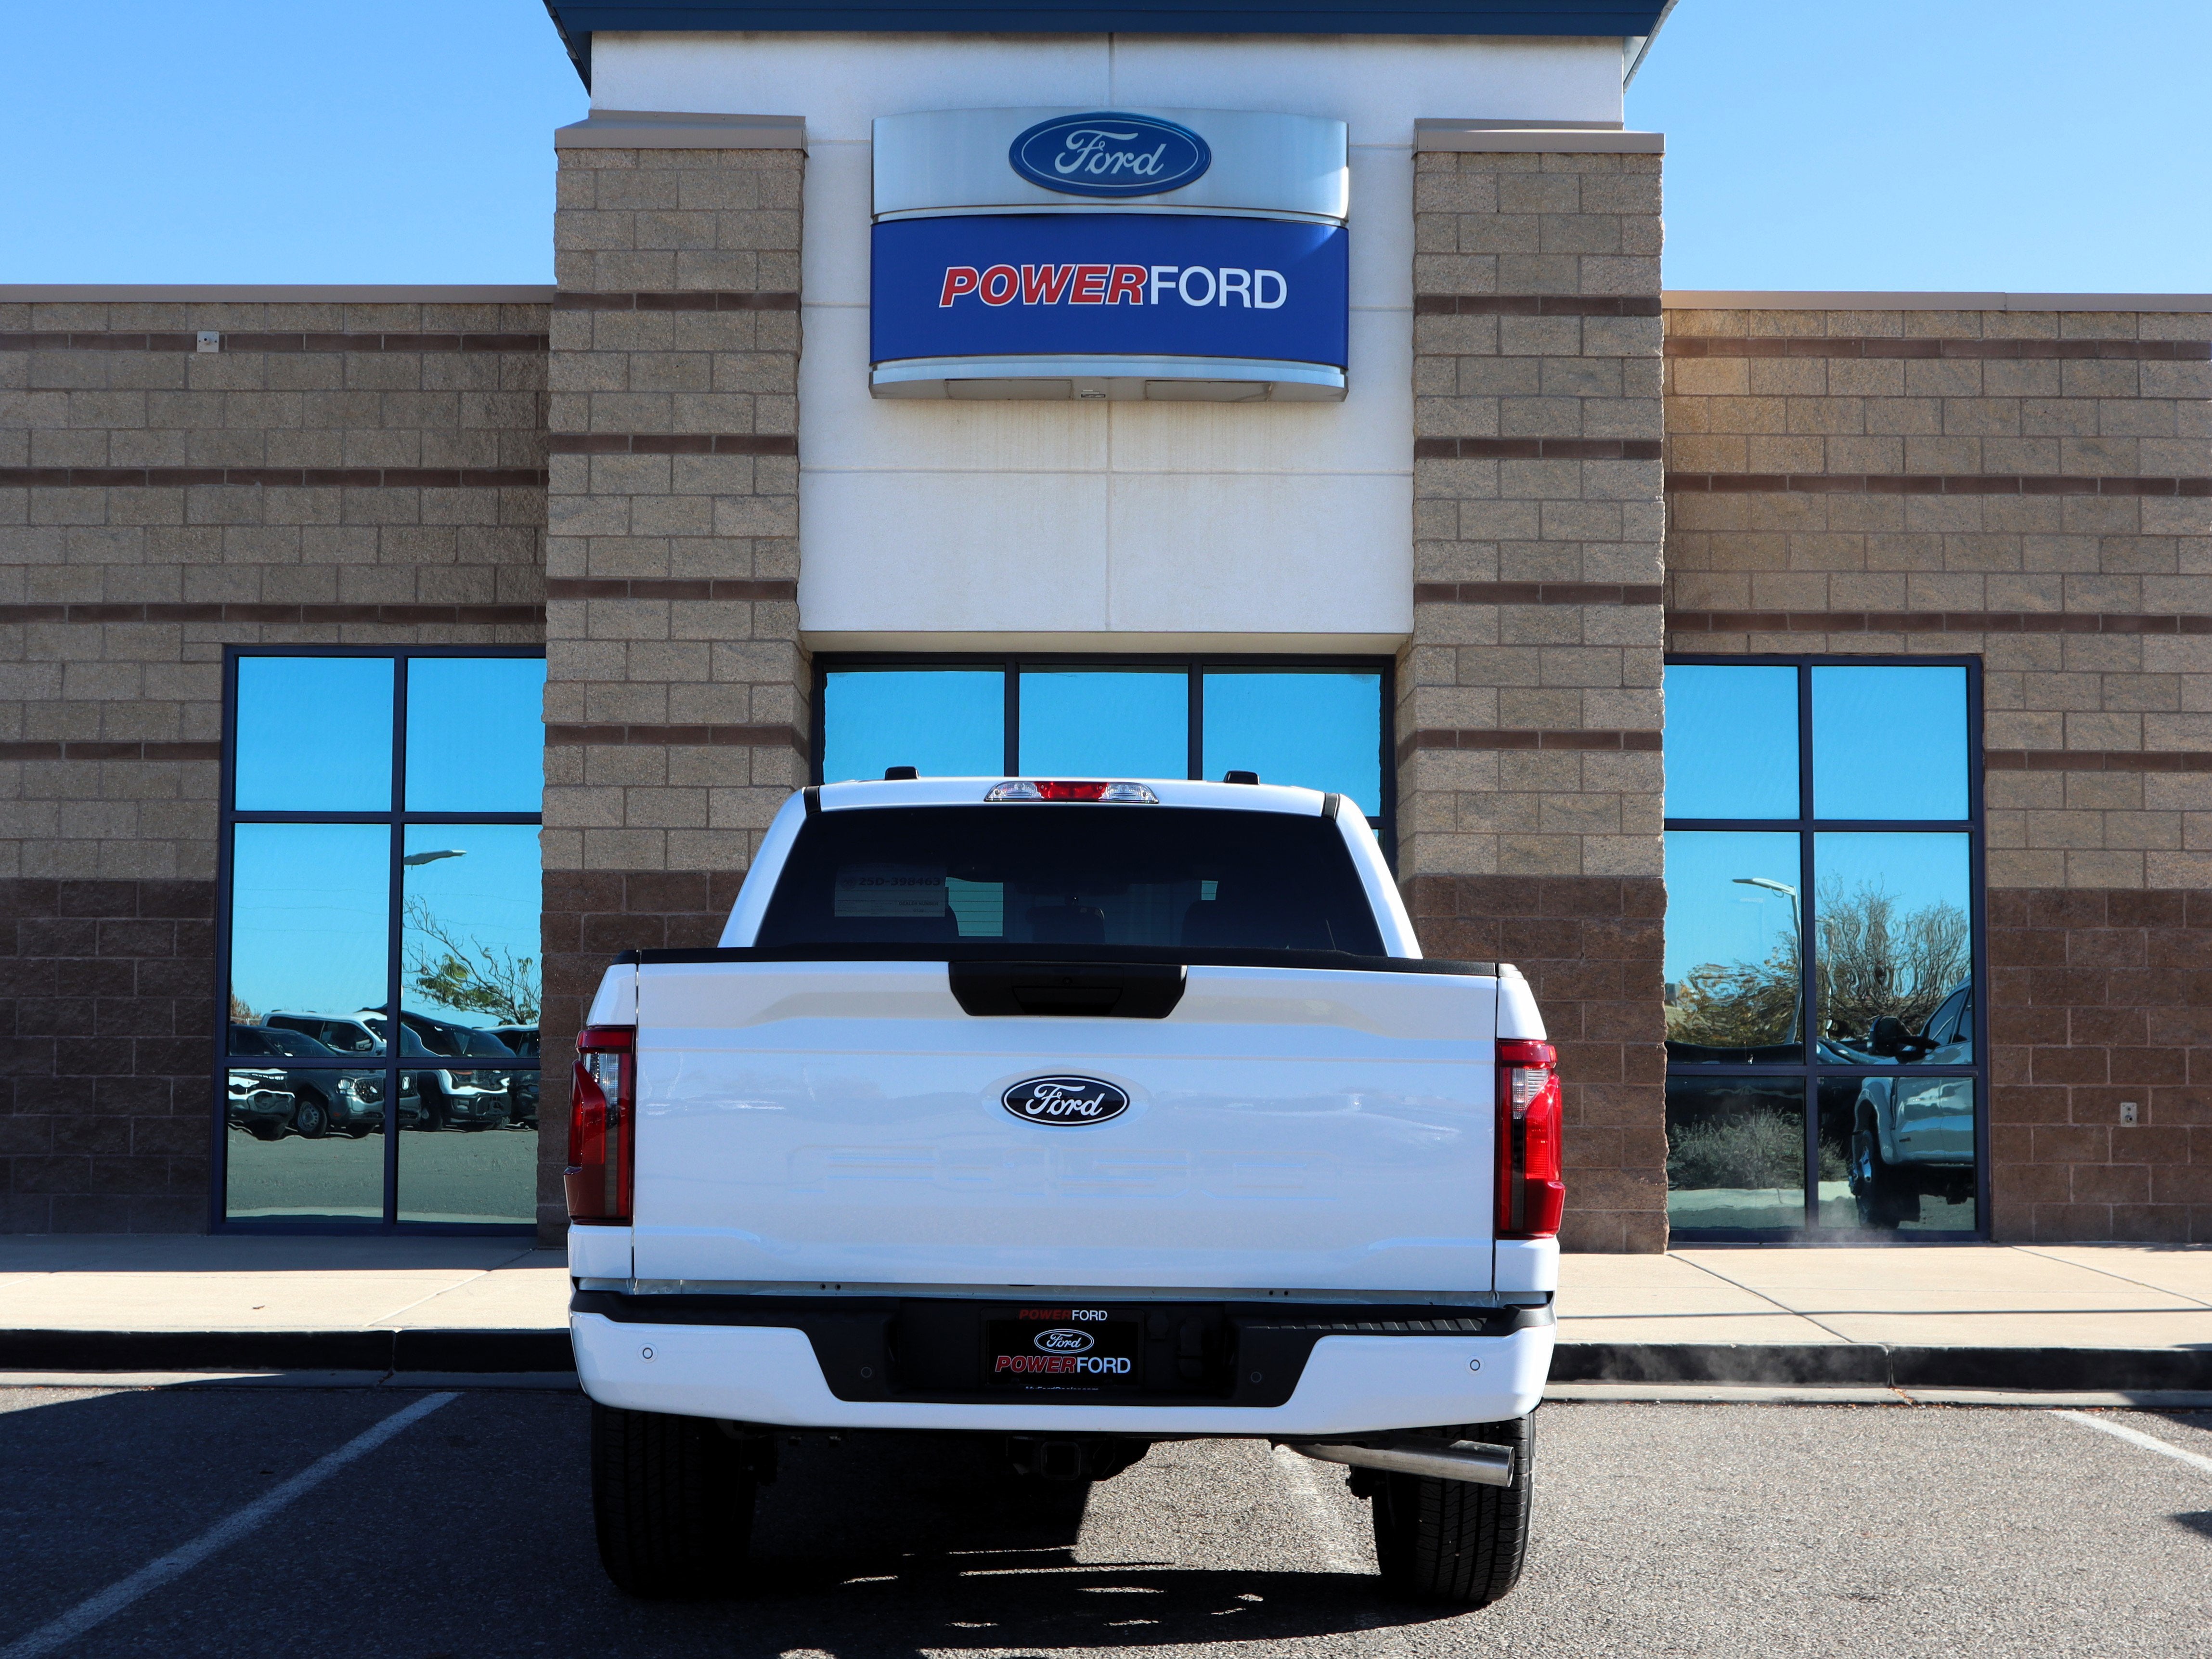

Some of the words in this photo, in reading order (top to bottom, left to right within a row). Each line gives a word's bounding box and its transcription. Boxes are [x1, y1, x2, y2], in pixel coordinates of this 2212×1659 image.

[1054, 129, 1167, 176] Ford
[1025, 1083, 1105, 1115] Ford
[1046, 1333, 1082, 1348] Ford
